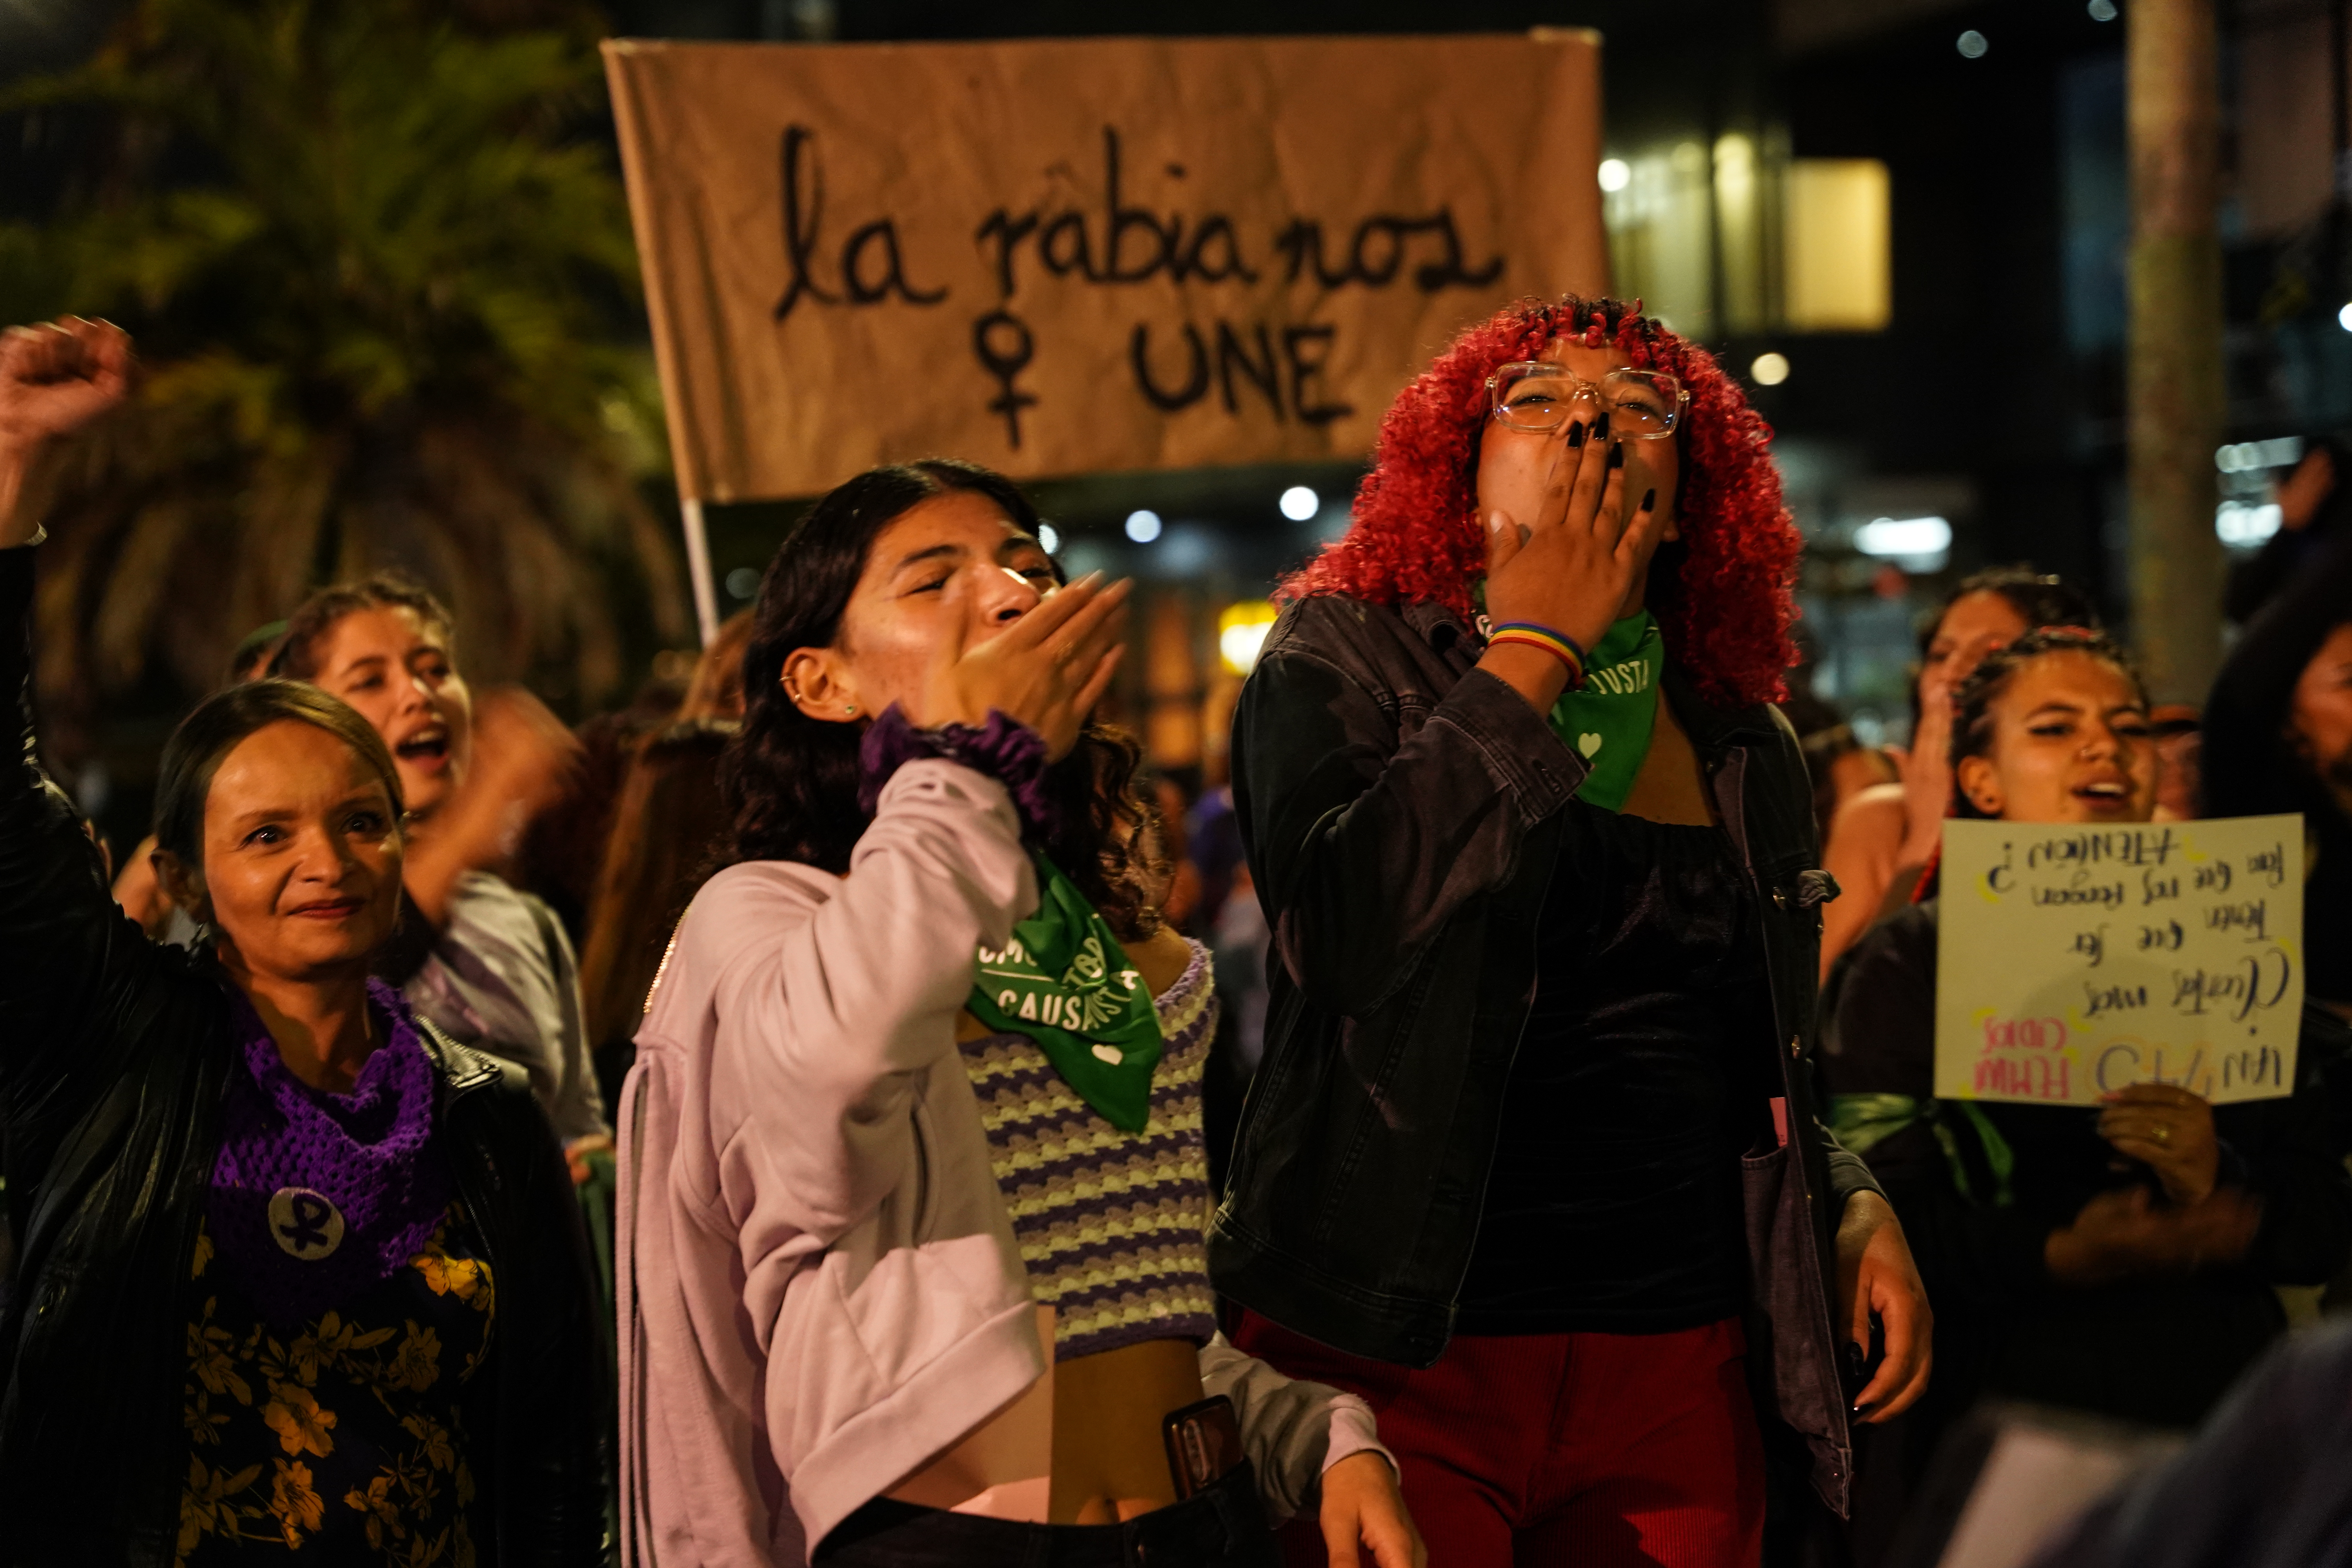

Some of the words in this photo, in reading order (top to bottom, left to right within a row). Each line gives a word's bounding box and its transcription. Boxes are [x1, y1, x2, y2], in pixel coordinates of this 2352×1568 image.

[774, 123, 949, 321] la
[975, 123, 1257, 296] rabia
[1275, 204, 1506, 291] nos
[1130, 319, 1355, 426] UNE
